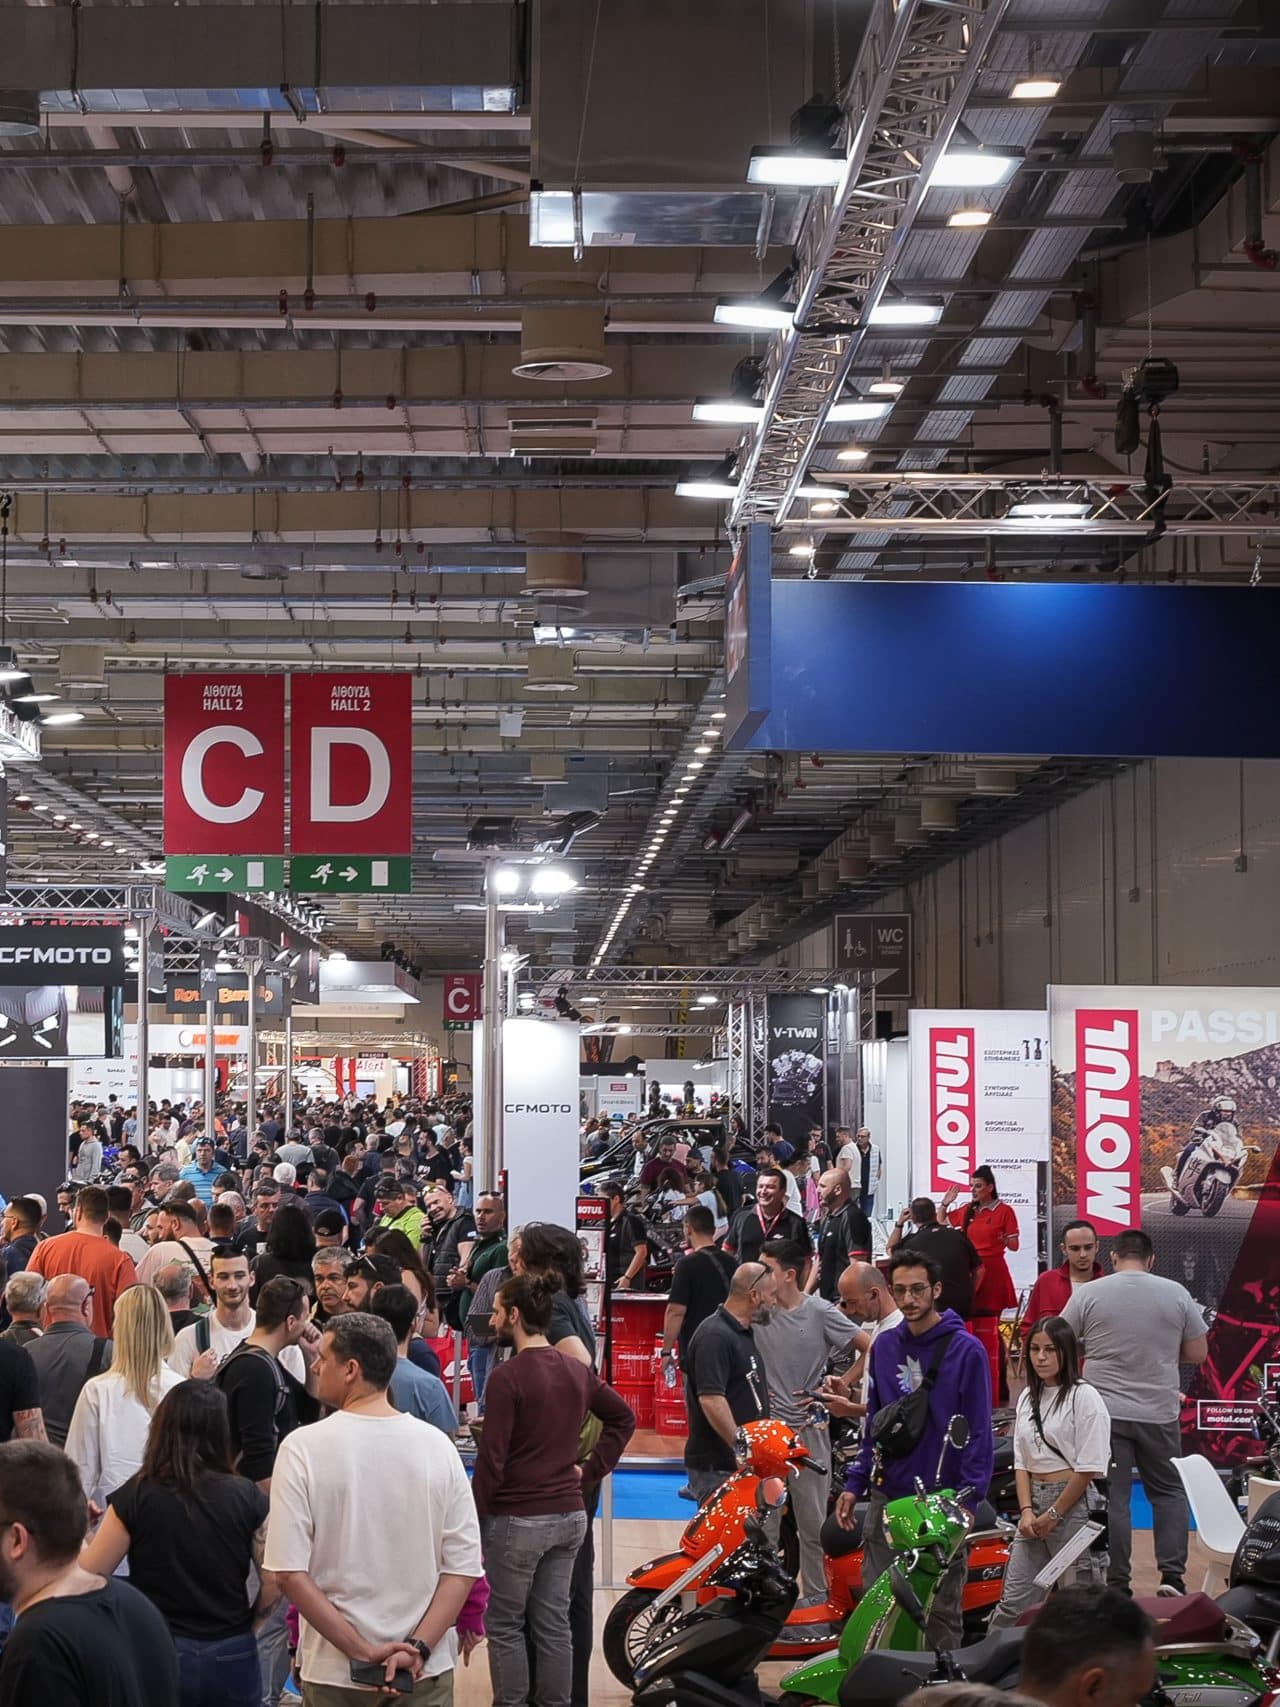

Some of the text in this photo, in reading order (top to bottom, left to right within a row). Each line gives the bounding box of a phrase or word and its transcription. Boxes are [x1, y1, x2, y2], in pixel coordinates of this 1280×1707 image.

[203, 685, 243, 697] ΑΙΘΟΥΣΑ
[331, 686, 371, 698] ΑΙΘΟΥΣΑ
[203, 699, 244, 711] HALL 2
[331, 700, 371, 712] HALL 2
[181, 725, 265, 824] C
[310, 727, 391, 822] D
[877, 928, 904, 943] WC
[448, 988, 471, 1014] C
[773, 1027, 818, 1039] V-TWIN
[504, 1104, 572, 1114] CFMOTO
[935, 1034, 971, 1187] MOTUL
[1084, 1019, 1132, 1227] MOTUL
